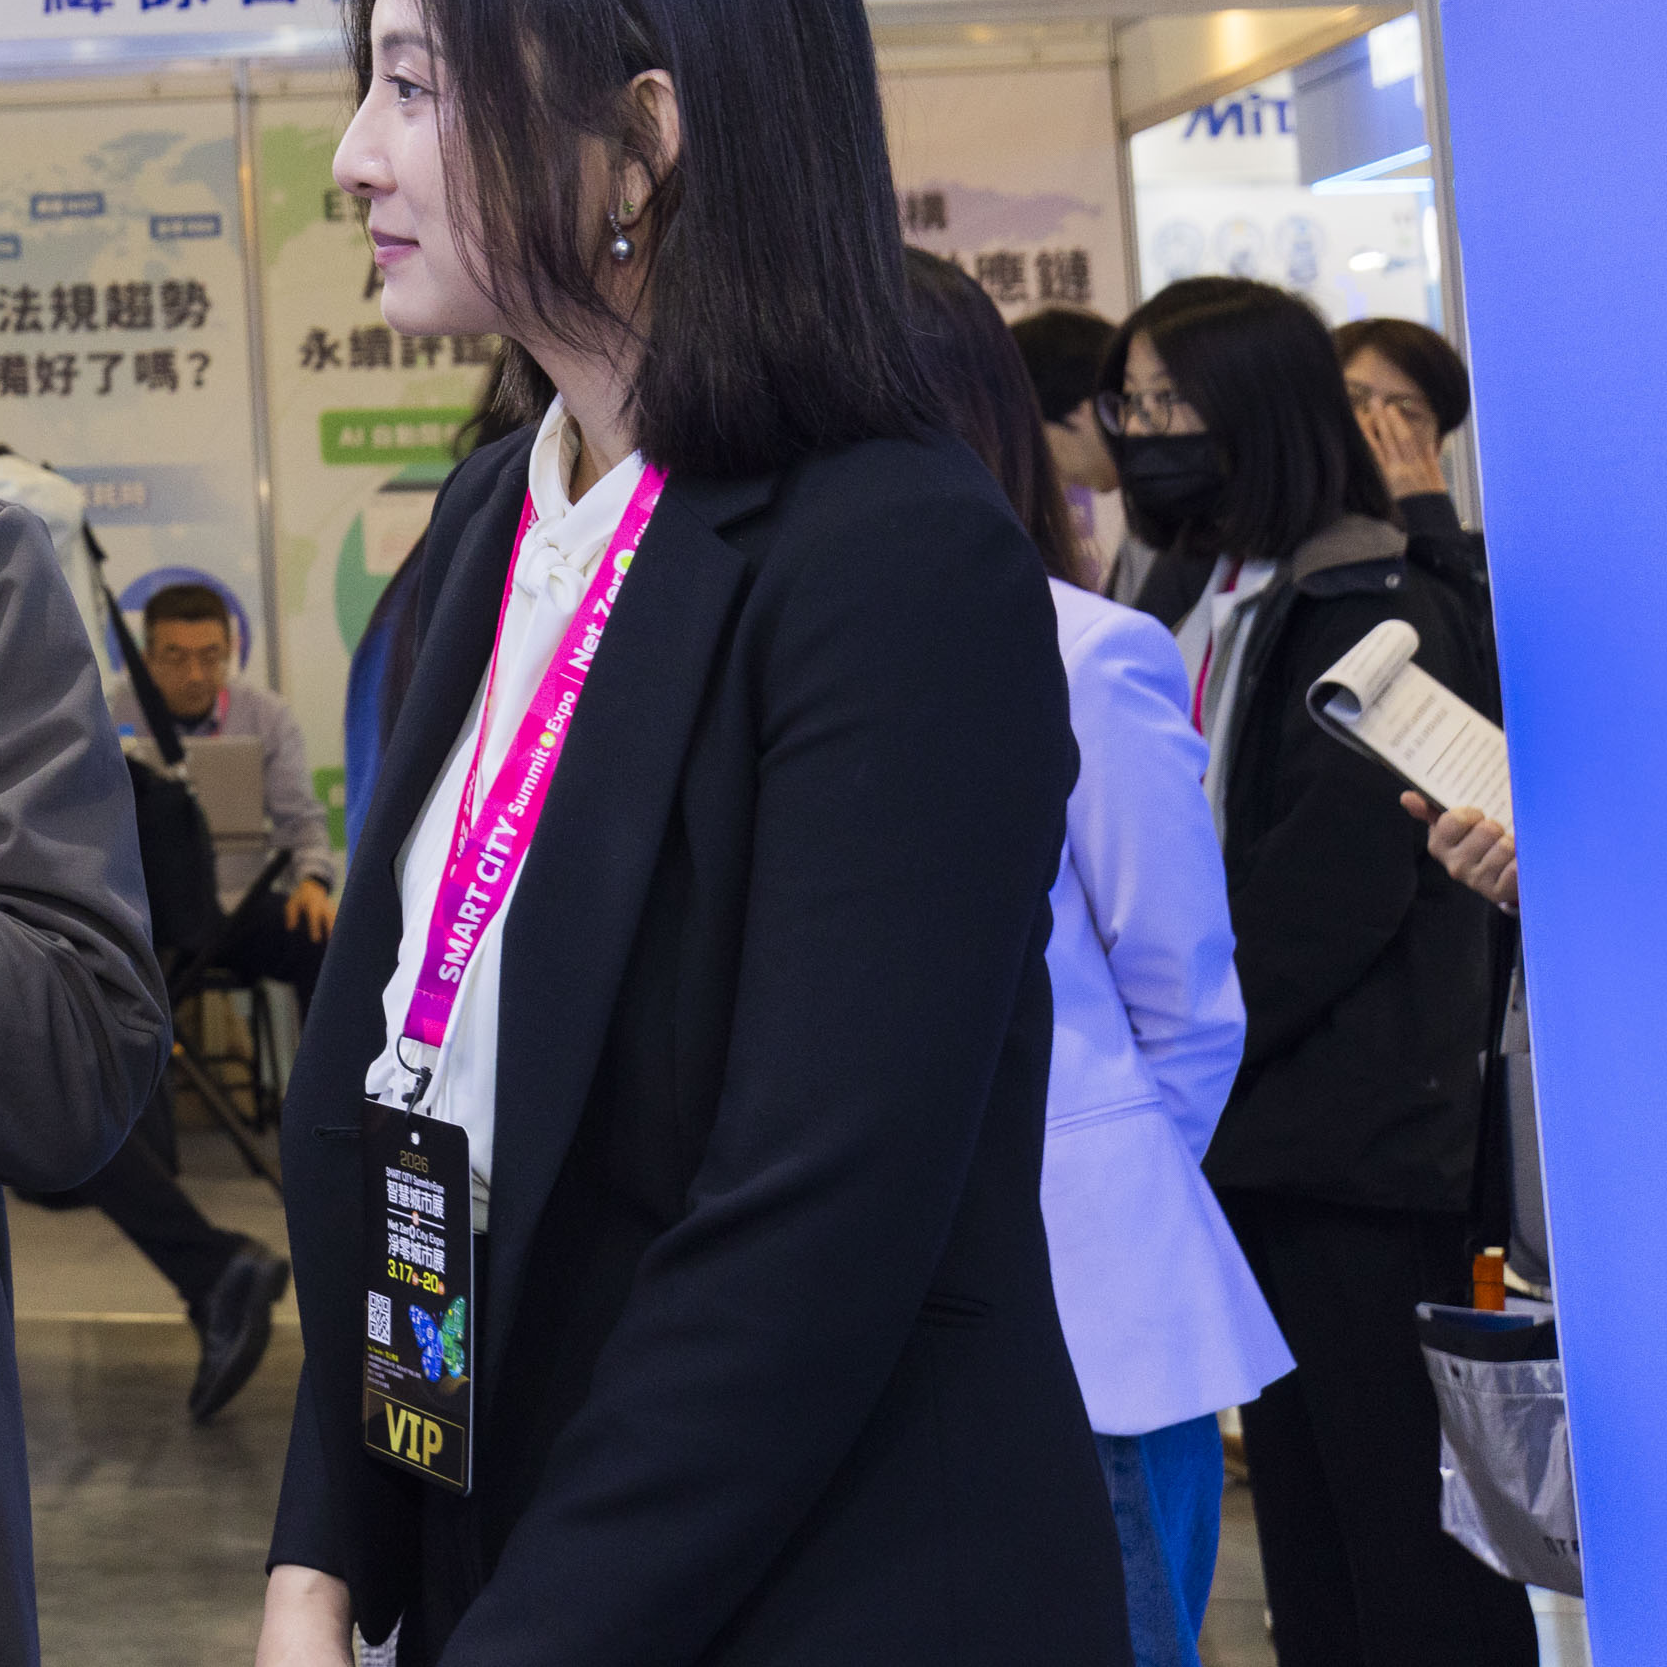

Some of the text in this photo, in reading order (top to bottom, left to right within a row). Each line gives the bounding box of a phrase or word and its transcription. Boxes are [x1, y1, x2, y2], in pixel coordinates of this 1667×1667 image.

[438, 881, 493, 984] SMART
[475, 814, 519, 885] CITY
[507, 747, 551, 818] Summit
[545, 689, 578, 734] Expo
[571, 623, 602, 673] Net
[399, 1149, 430, 1174] 2026
[384, 1401, 444, 1467] VIP
